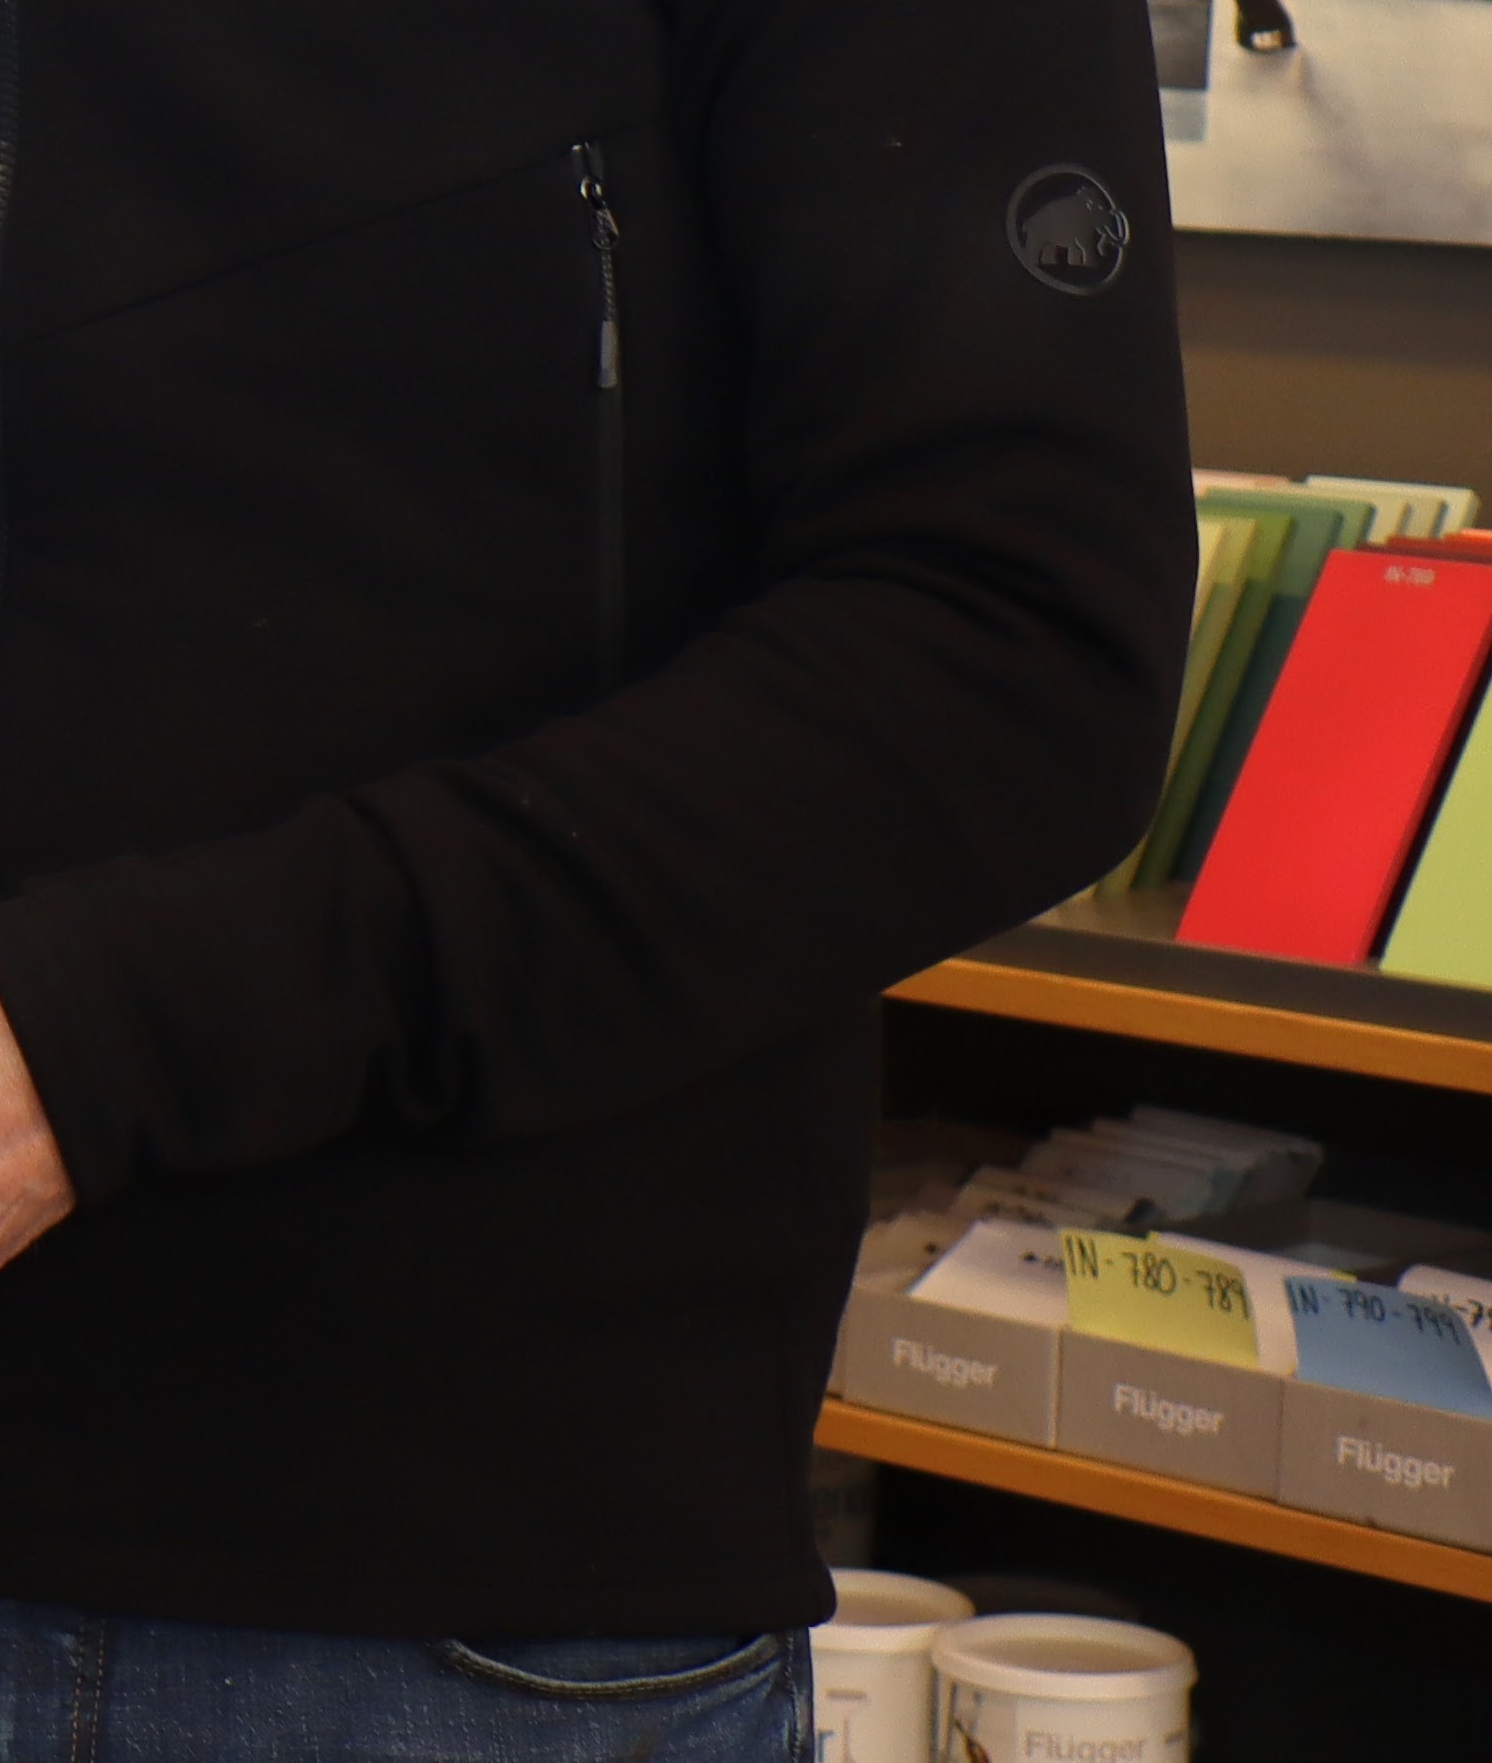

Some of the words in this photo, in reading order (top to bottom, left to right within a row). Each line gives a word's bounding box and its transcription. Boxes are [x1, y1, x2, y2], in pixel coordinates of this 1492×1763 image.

[892, 1338, 998, 1388] Flügger
[1113, 1383, 1225, 1437] Flügger
[1334, 1434, 1457, 1489] Flügger
